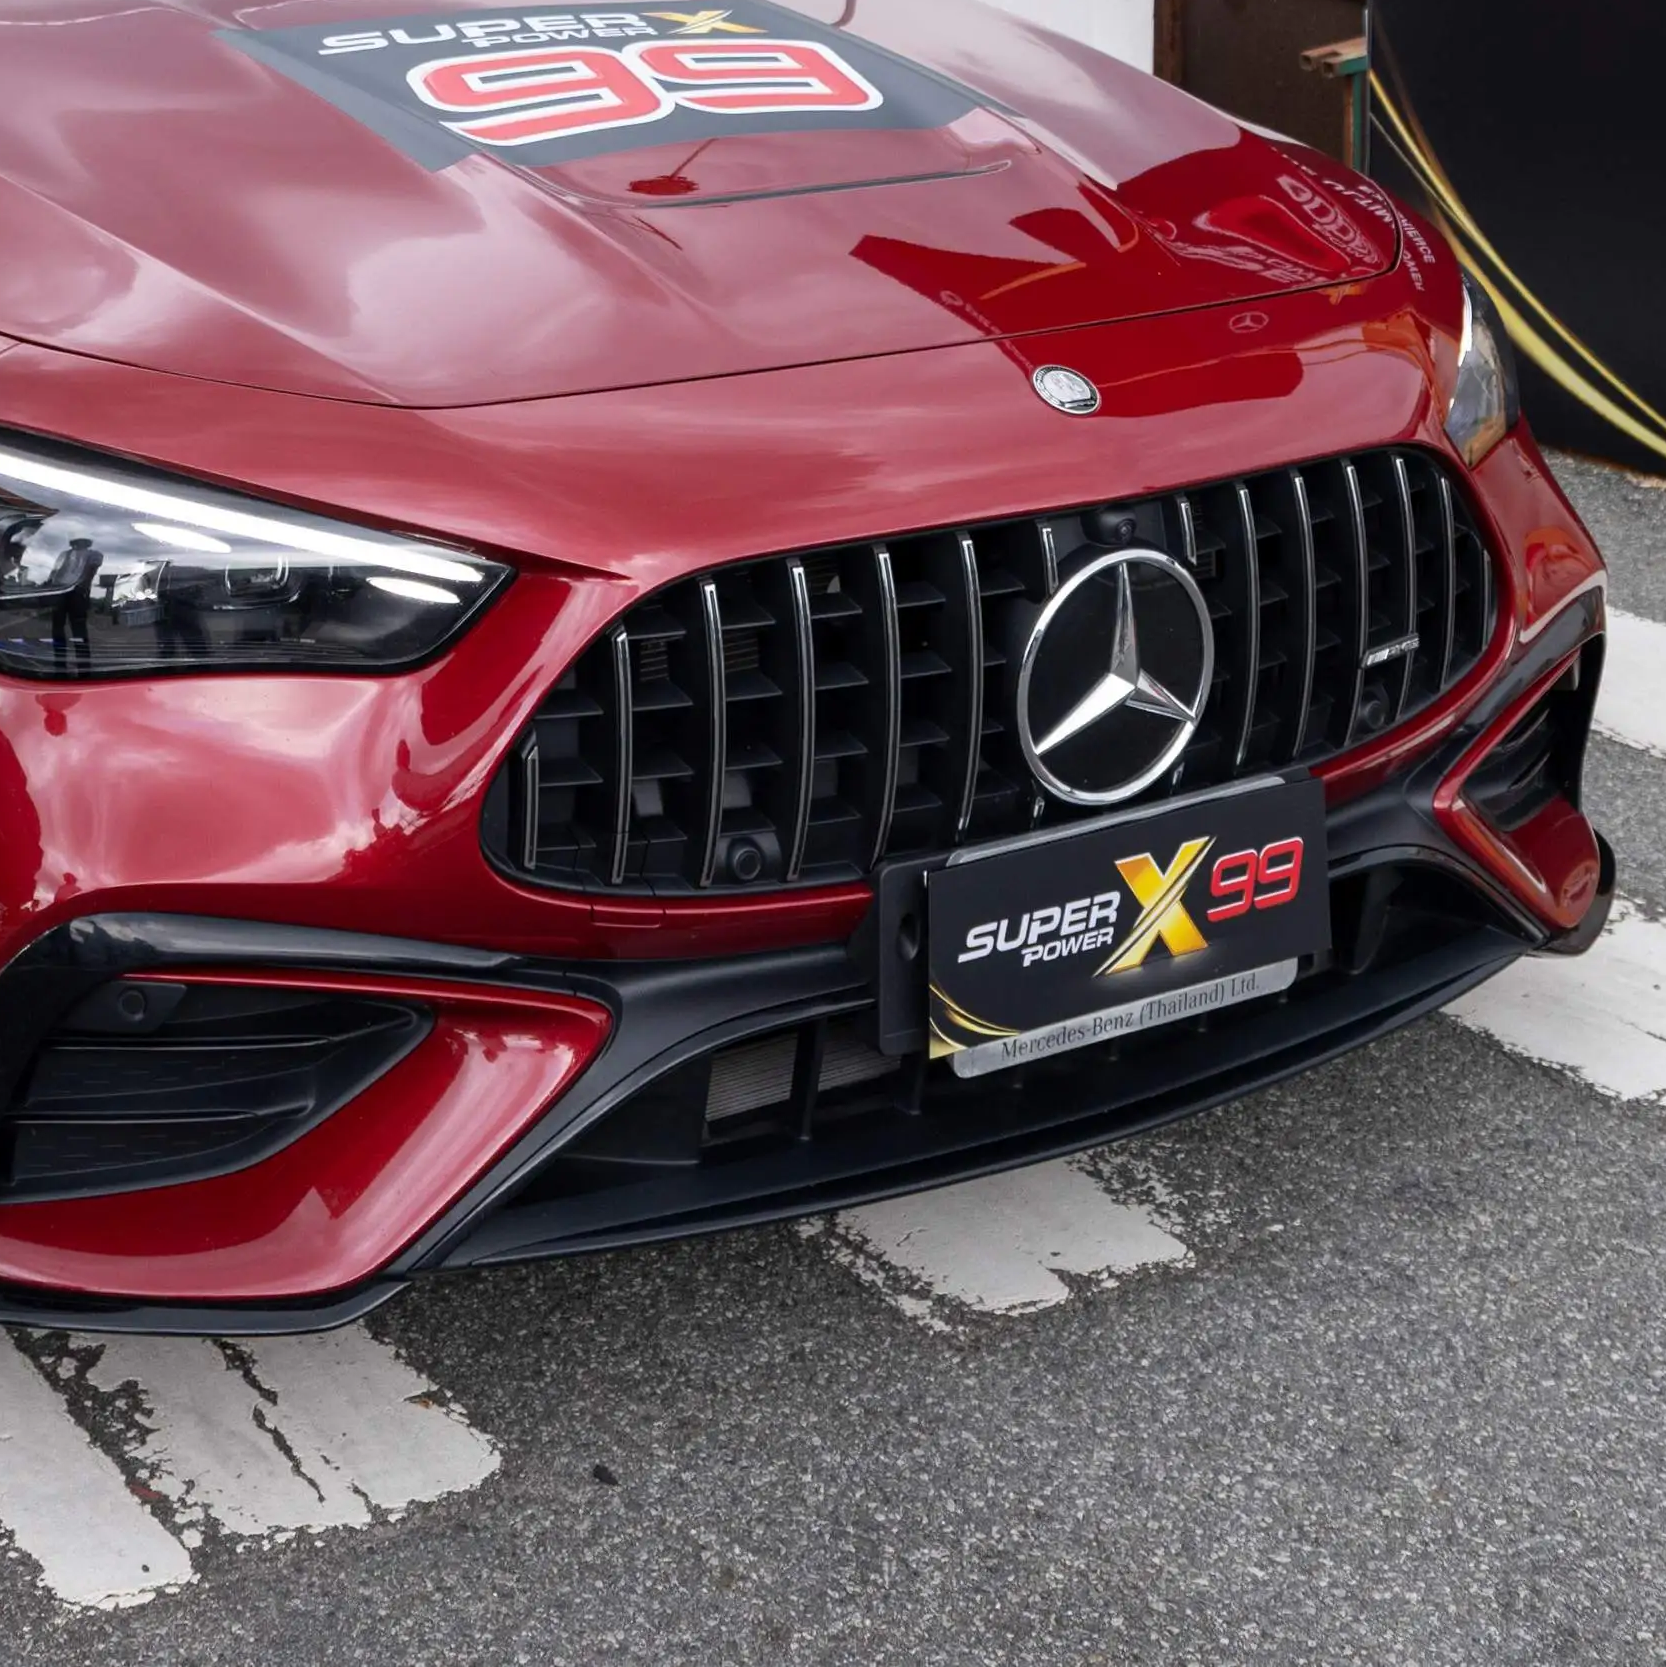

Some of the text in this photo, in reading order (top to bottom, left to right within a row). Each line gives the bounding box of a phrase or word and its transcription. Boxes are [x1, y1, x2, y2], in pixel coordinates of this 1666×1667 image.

[318, 8, 768, 56] SUPER X
[460, 26, 659, 49] POWER
[405, 37, 885, 148] 99
[958, 835, 1304, 979] SUPER X 99
[1021, 926, 1115, 968] POWER
[1001, 972, 1260, 1062] Mercedes-Benz (Thailand) Ltd.
